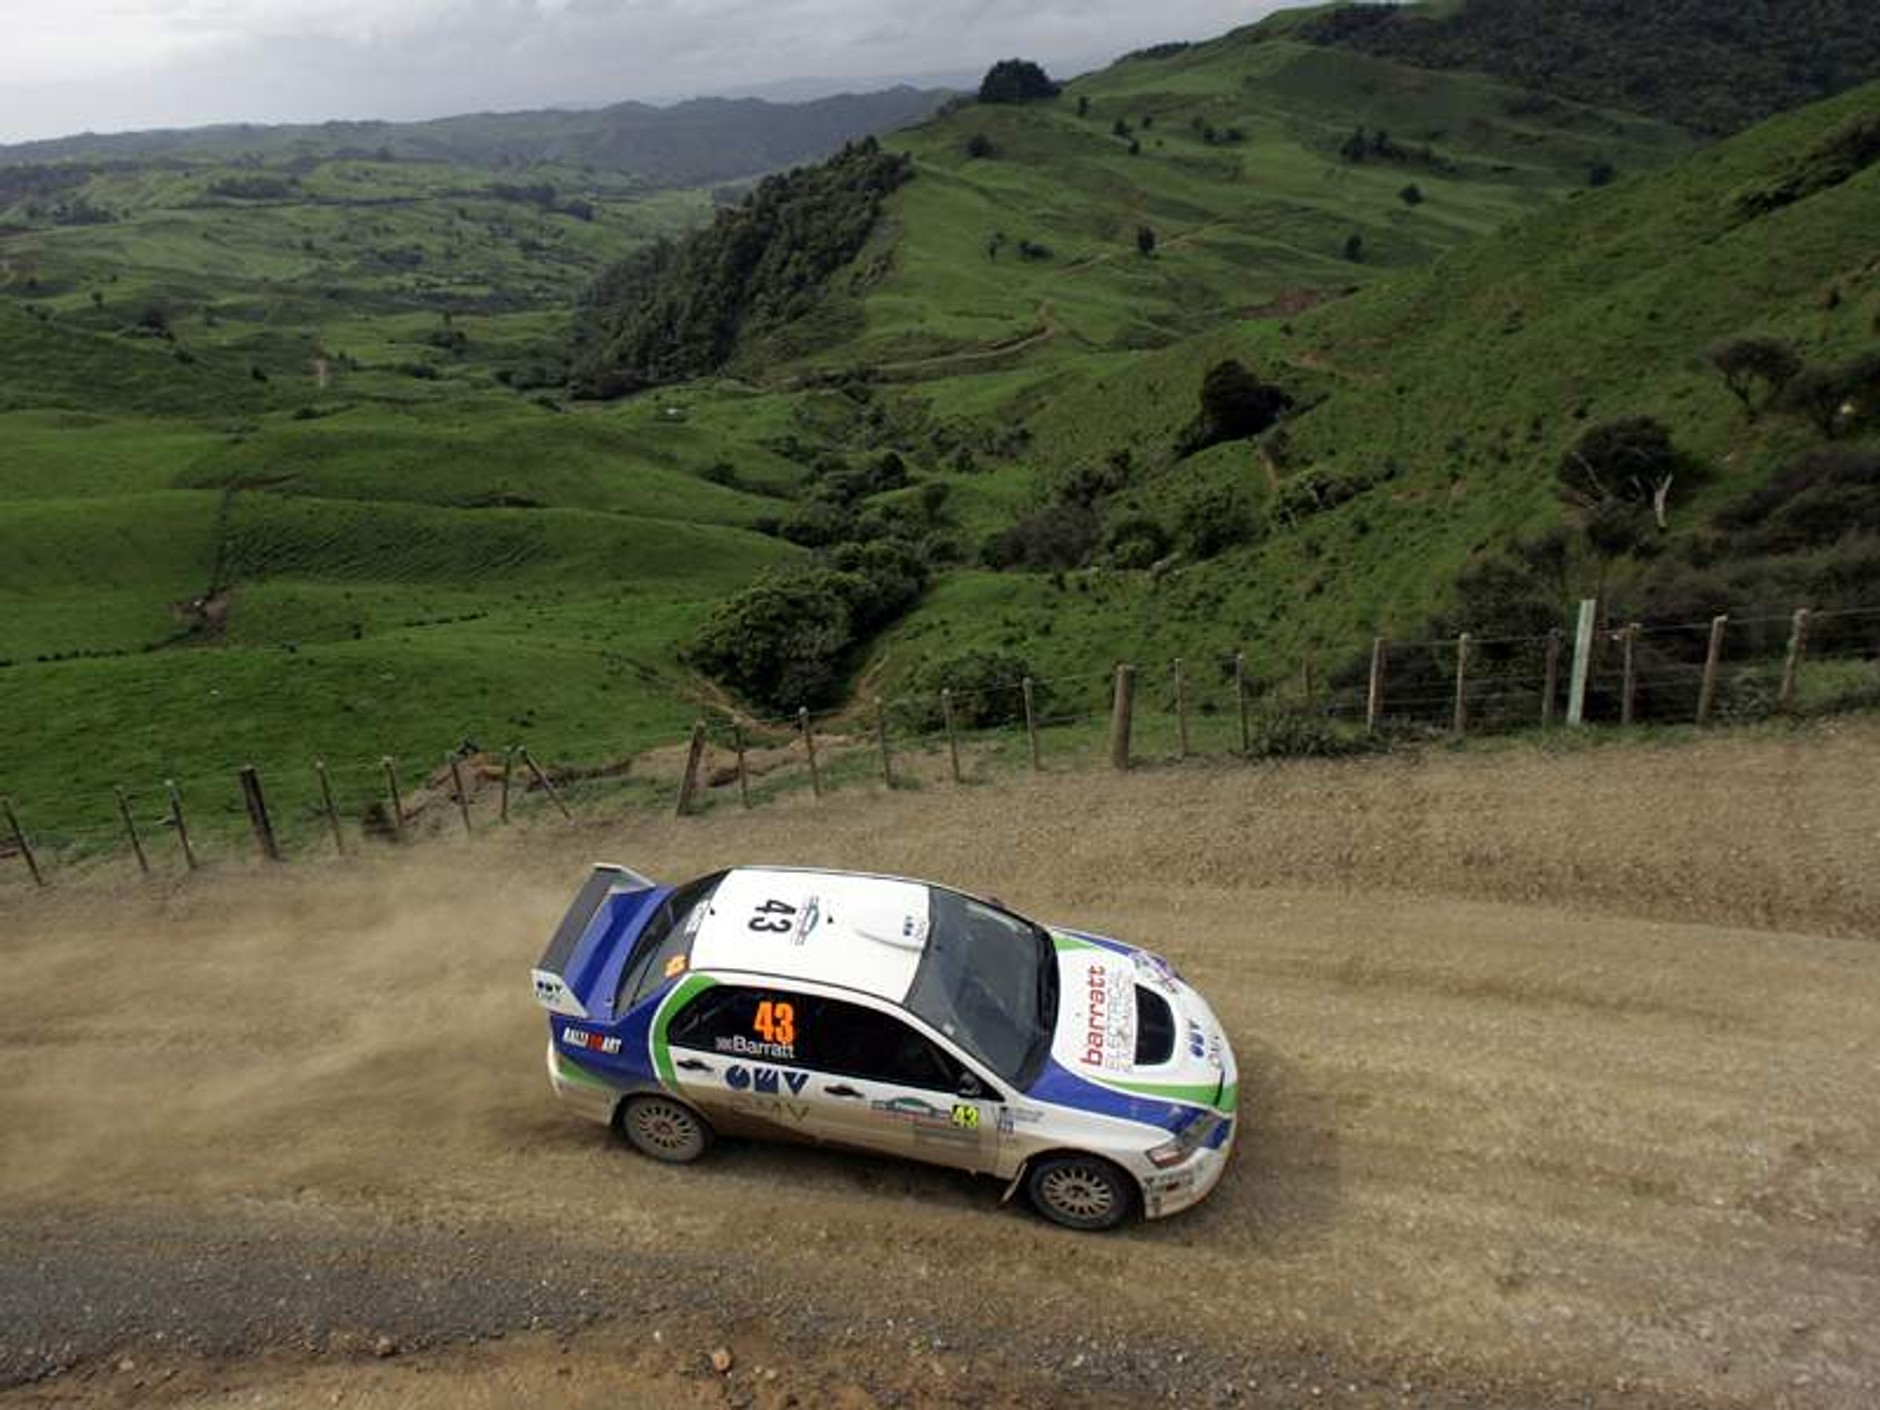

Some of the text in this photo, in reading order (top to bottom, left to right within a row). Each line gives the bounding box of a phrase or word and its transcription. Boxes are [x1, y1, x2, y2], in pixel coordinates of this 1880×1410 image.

[748, 899, 796, 932] 43
[754, 1001, 794, 1045] 43
[1080, 966, 1105, 1066] barratt
[733, 1035, 795, 1059] Barratt
[953, 1105, 979, 1129] 43
